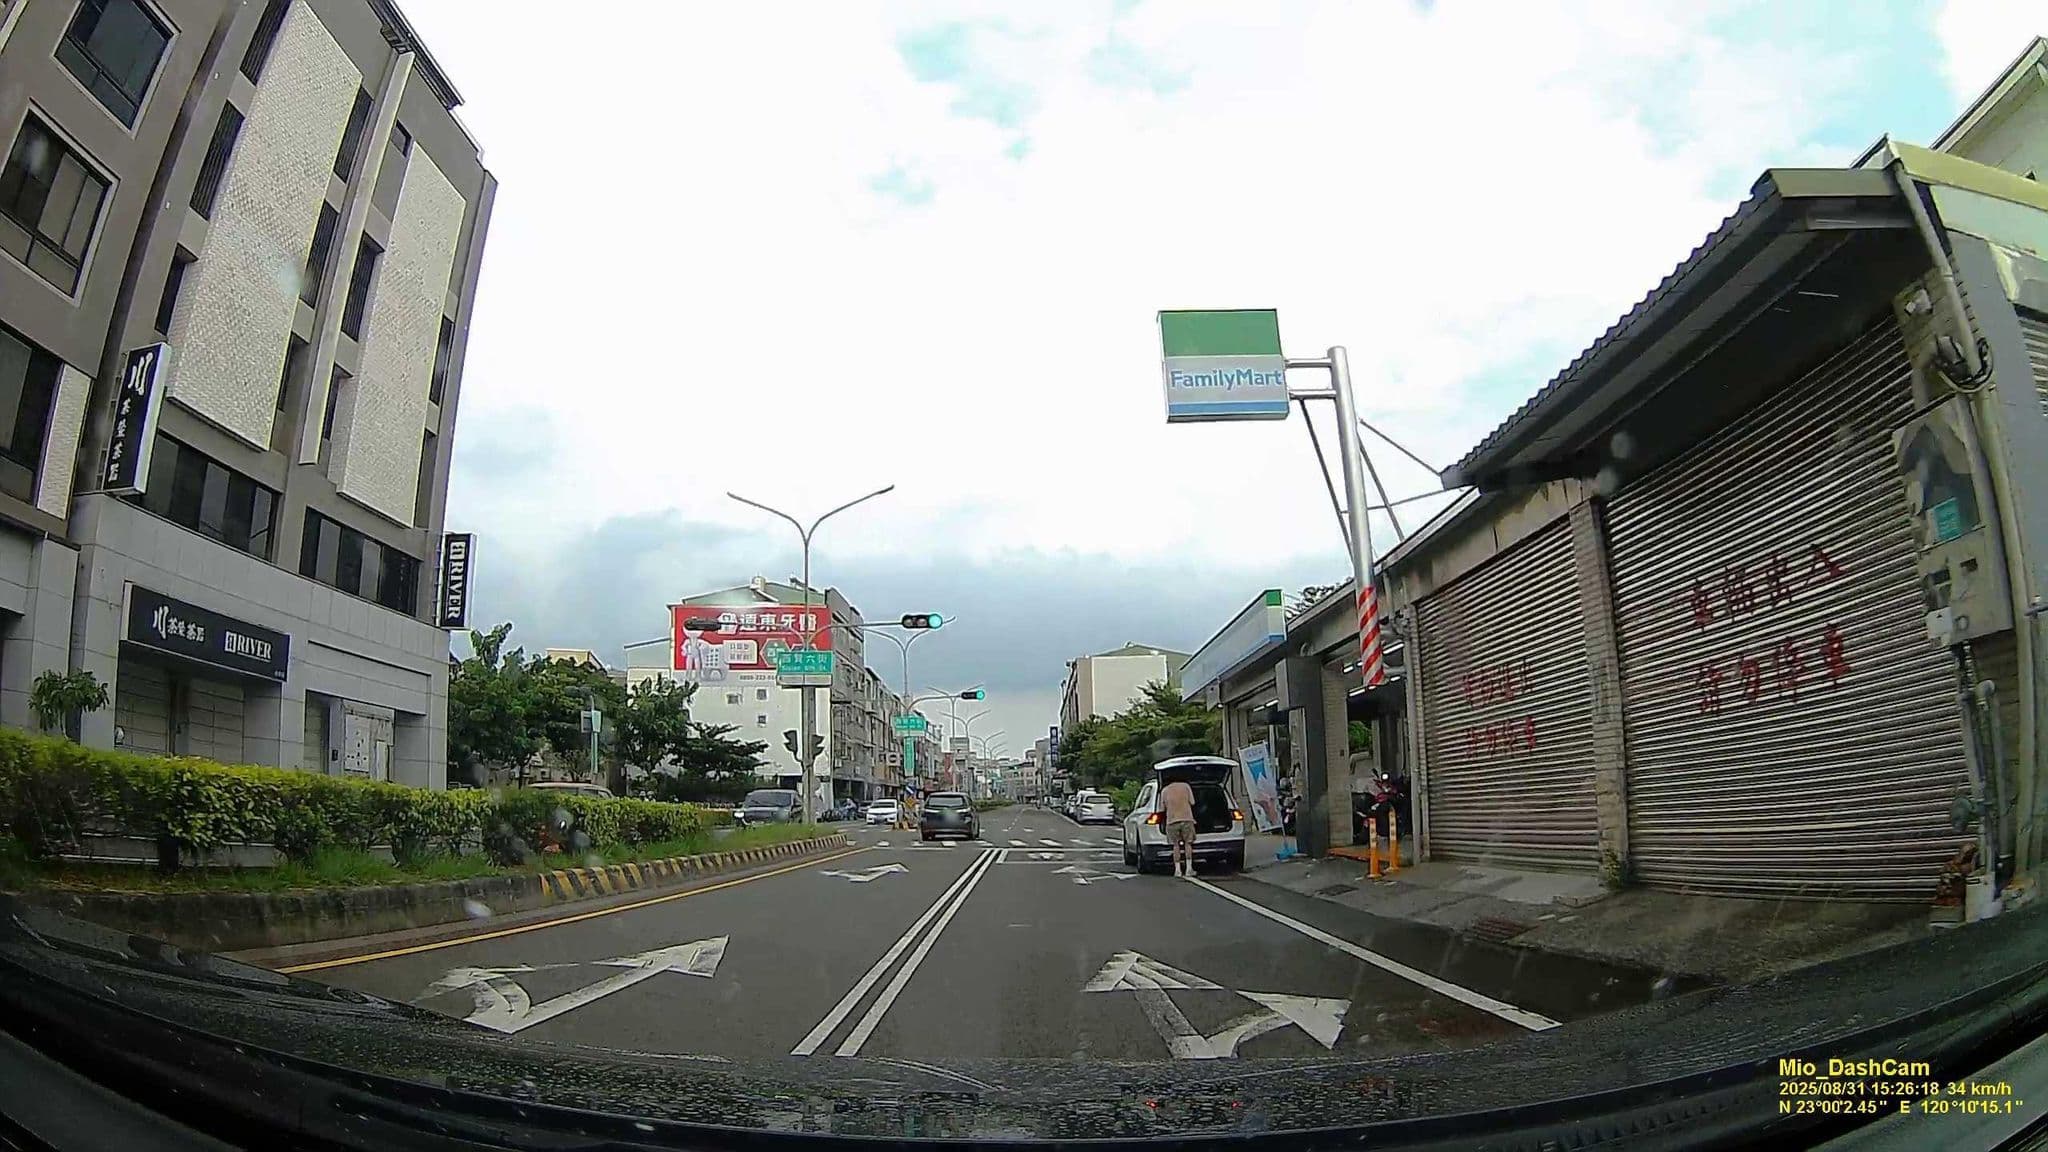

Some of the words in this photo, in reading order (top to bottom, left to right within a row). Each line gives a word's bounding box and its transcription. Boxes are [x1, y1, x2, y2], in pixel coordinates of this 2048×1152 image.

[1170, 368, 1283, 391] FamilyMart
[447, 561, 464, 620] RIVER
[237, 634, 272, 660] RIVER
